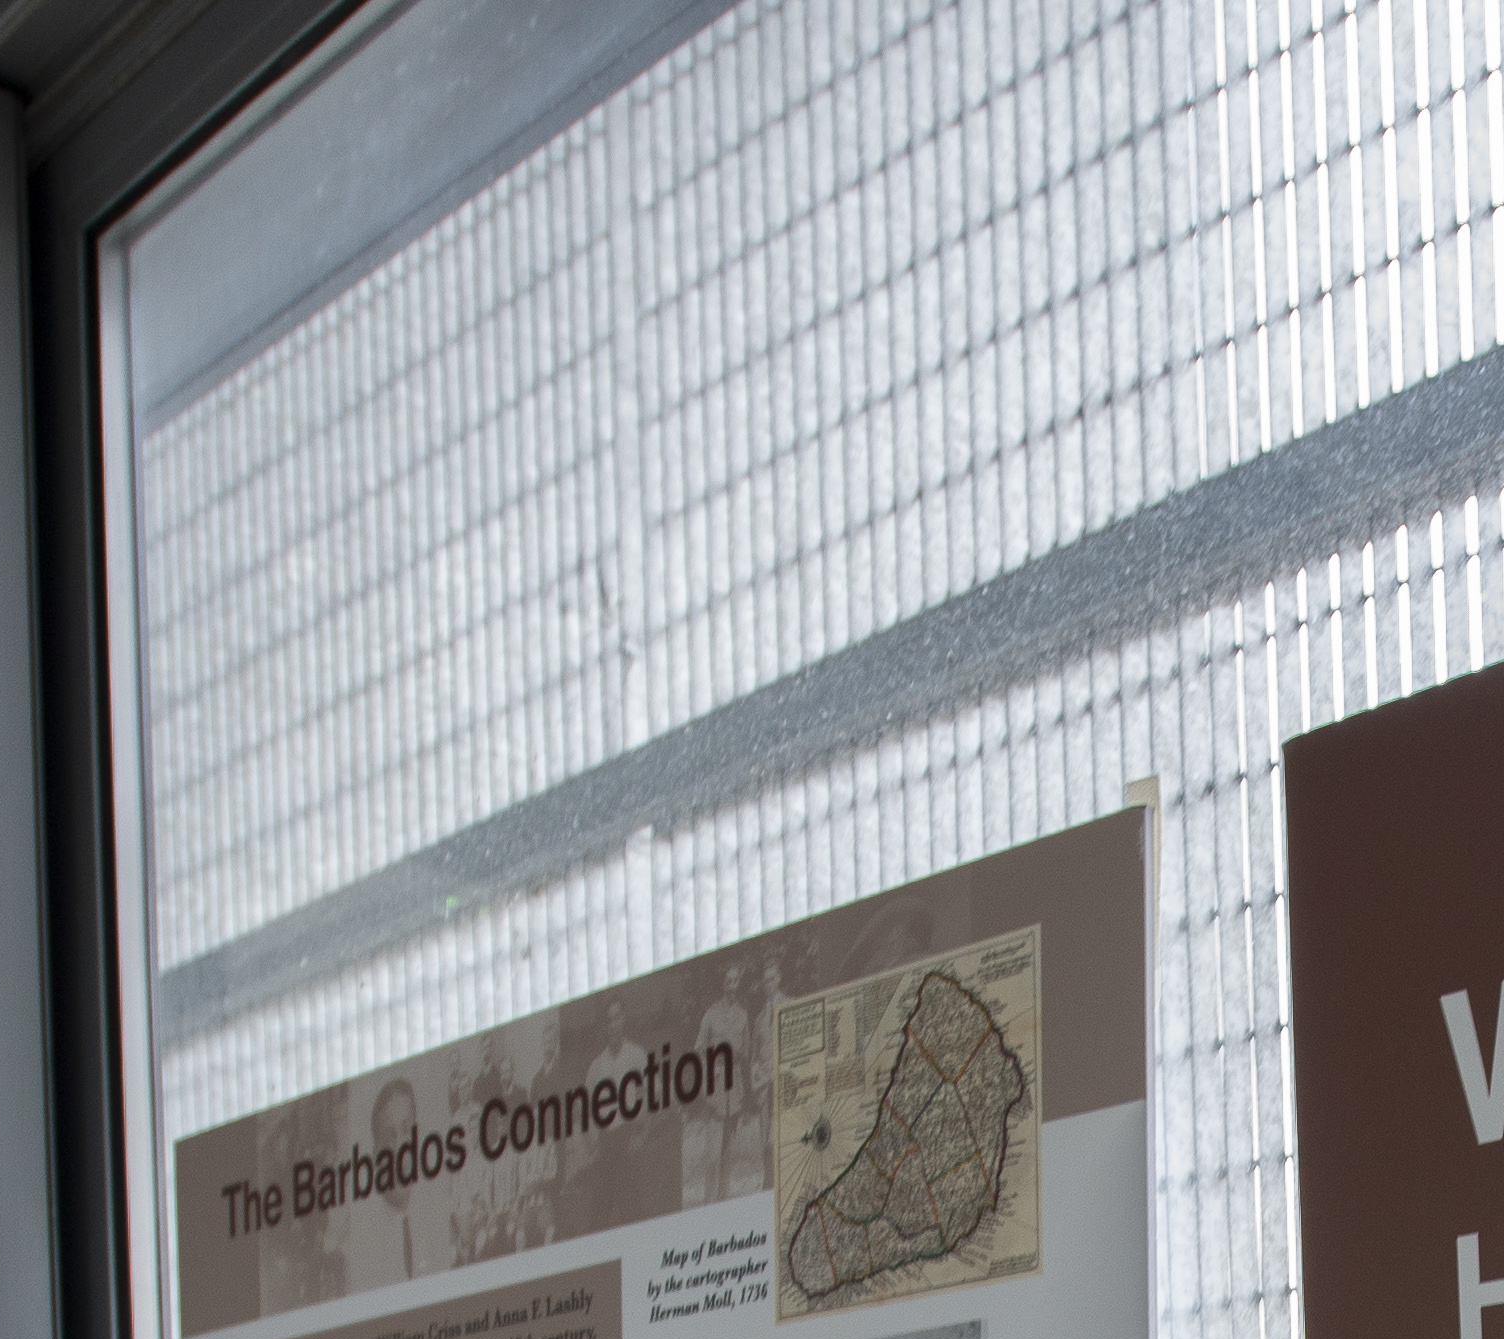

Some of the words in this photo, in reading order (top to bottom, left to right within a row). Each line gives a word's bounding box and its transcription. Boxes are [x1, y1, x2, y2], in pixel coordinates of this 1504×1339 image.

[221, 1179, 284, 1239] The
[292, 1125, 467, 1219] Barbados
[479, 1041, 734, 1161] Connection
[661, 1249, 688, 1269] Map
[691, 1241, 705, 1265] of
[708, 1231, 767, 1257] Barbados
[647, 1280, 661, 1302] by
[665, 1275, 683, 1293] the
[686, 1258, 768, 1287] cartographer
[650, 1302, 699, 1323] Herman
[702, 1289, 735, 1312] Moll,
[740, 1281, 769, 1303] 1736
